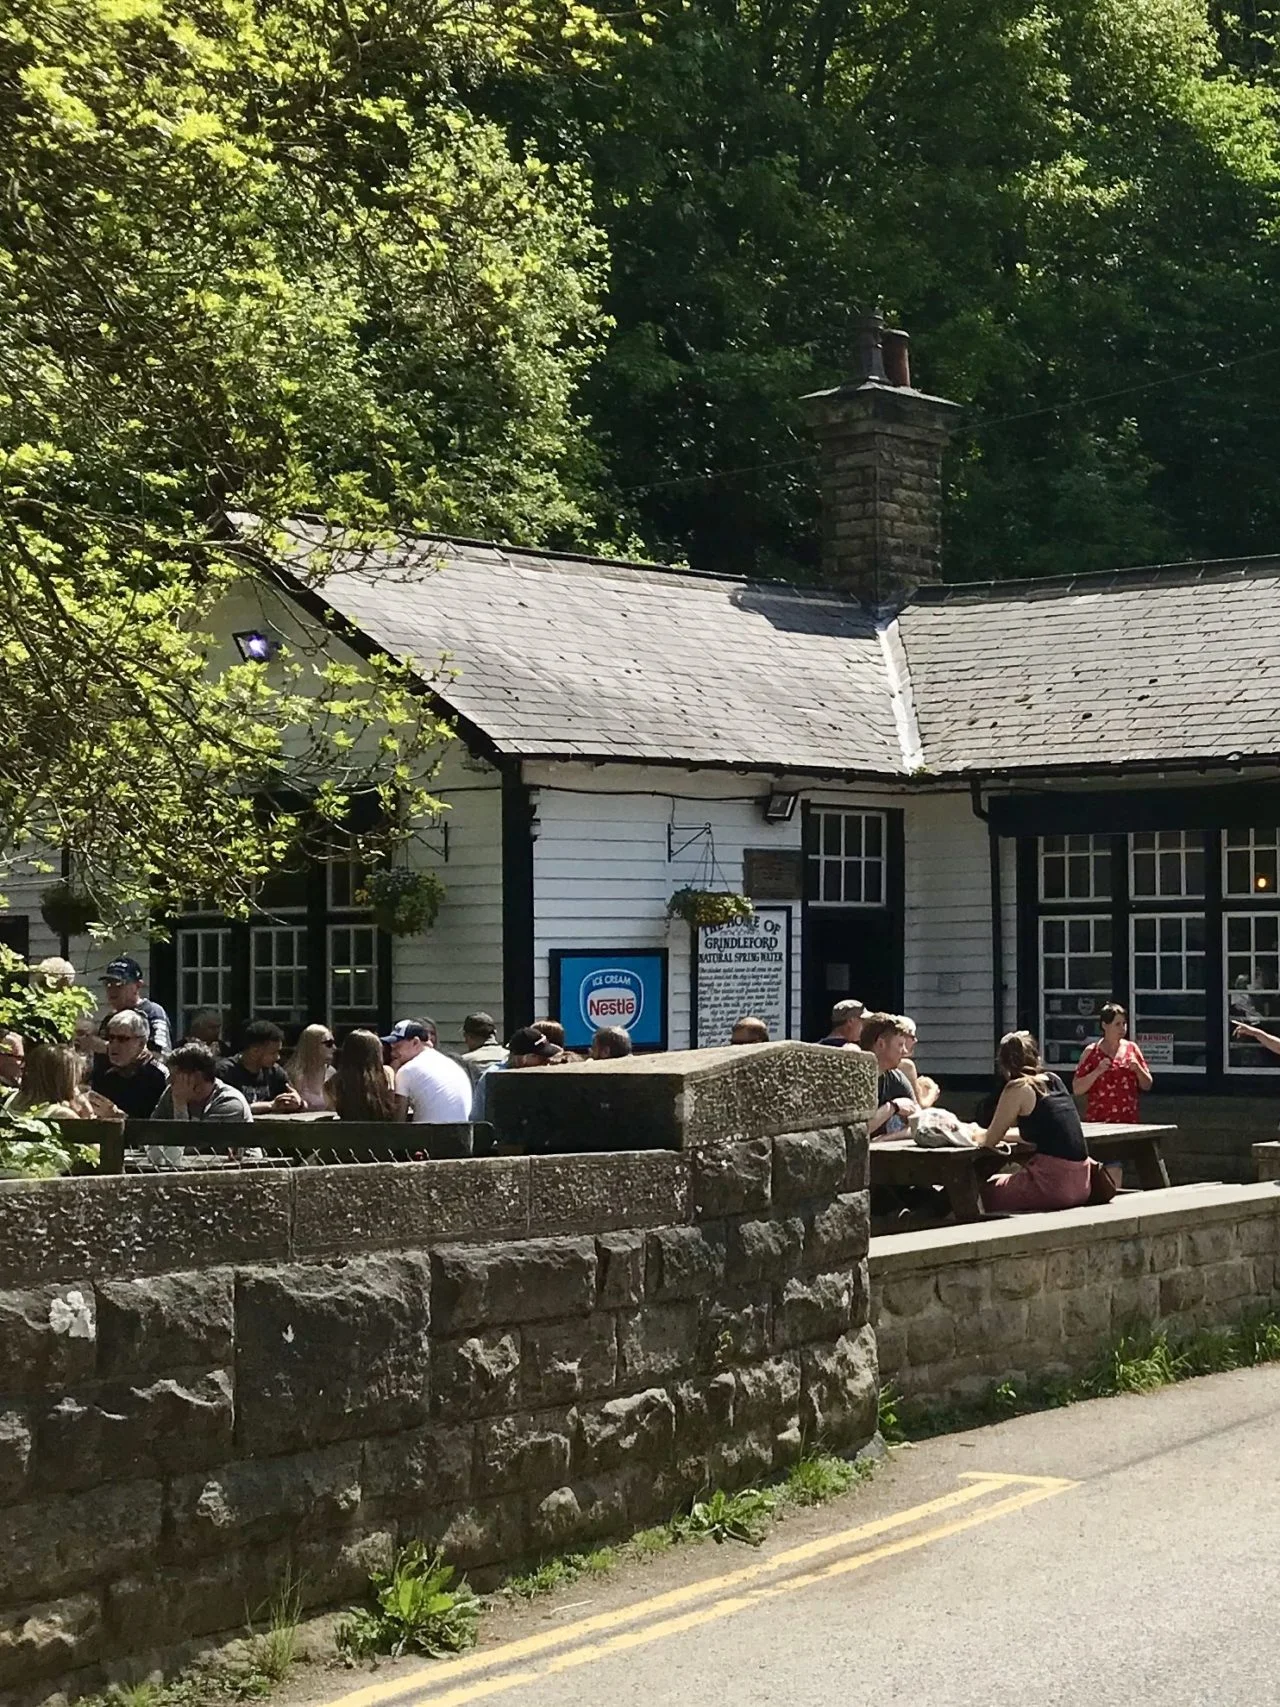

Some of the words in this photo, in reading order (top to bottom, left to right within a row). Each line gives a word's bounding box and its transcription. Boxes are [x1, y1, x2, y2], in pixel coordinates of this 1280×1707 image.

[764, 919, 781, 935] OF
[704, 936, 779, 952] GRINDLEFORD
[699, 953, 733, 963] NATURAL
[734, 952, 760, 962] SPRING
[761, 952, 784, 962] WATER
[592, 976, 603, 987] ICE
[604, 975, 631, 985] CREAM
[1136, 1034, 1172, 1042] WARNING
